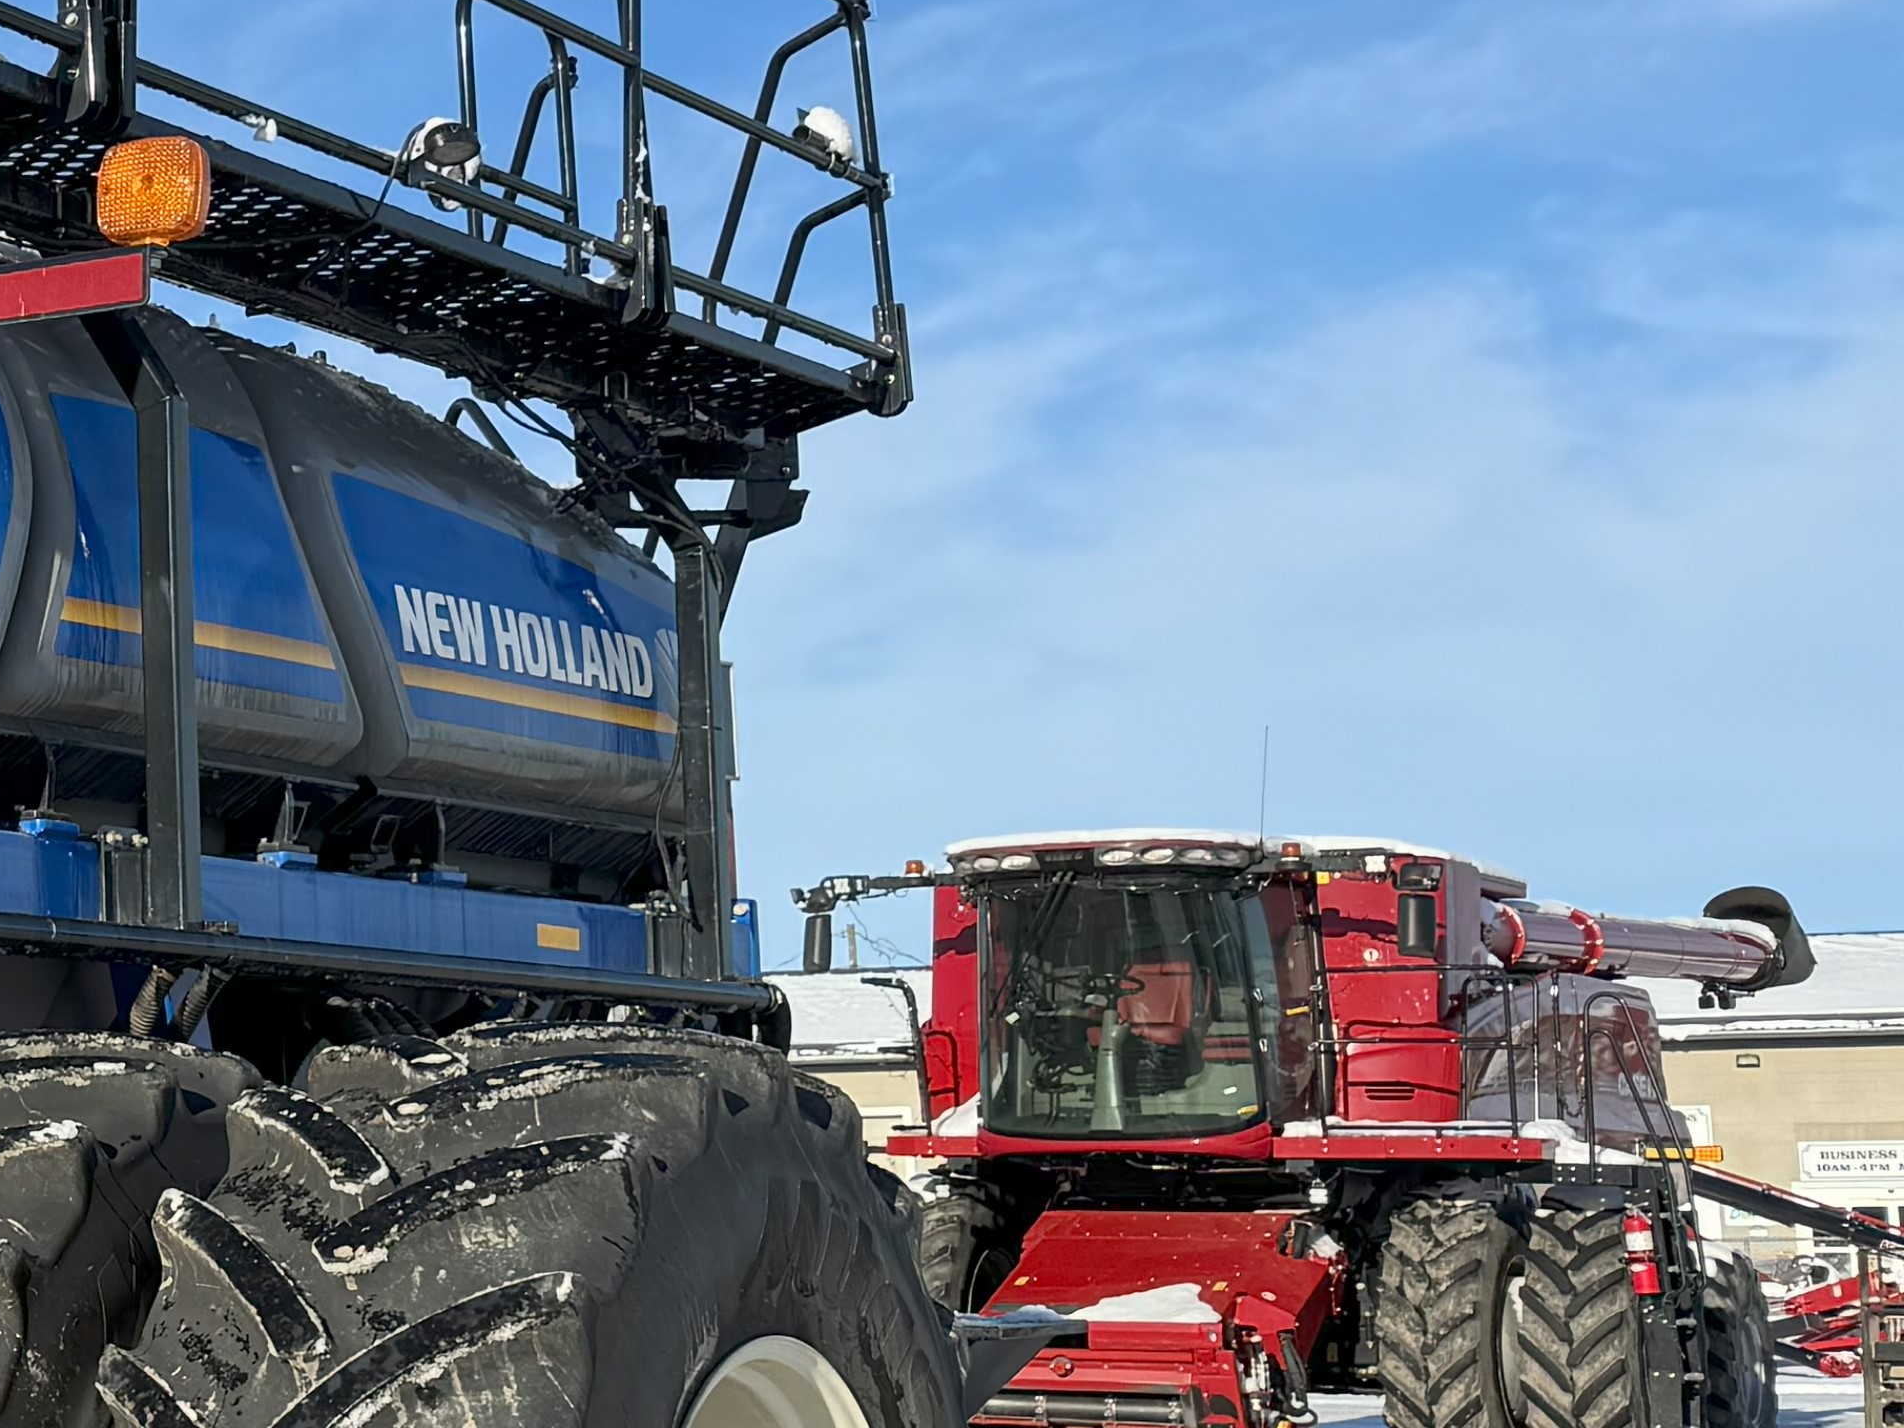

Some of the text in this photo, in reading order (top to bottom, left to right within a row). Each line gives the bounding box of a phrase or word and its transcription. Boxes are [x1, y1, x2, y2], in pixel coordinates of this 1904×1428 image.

[394, 584, 654, 699] NEW HOLLAND
[1820, 1149, 1898, 1160] BUSINESS
